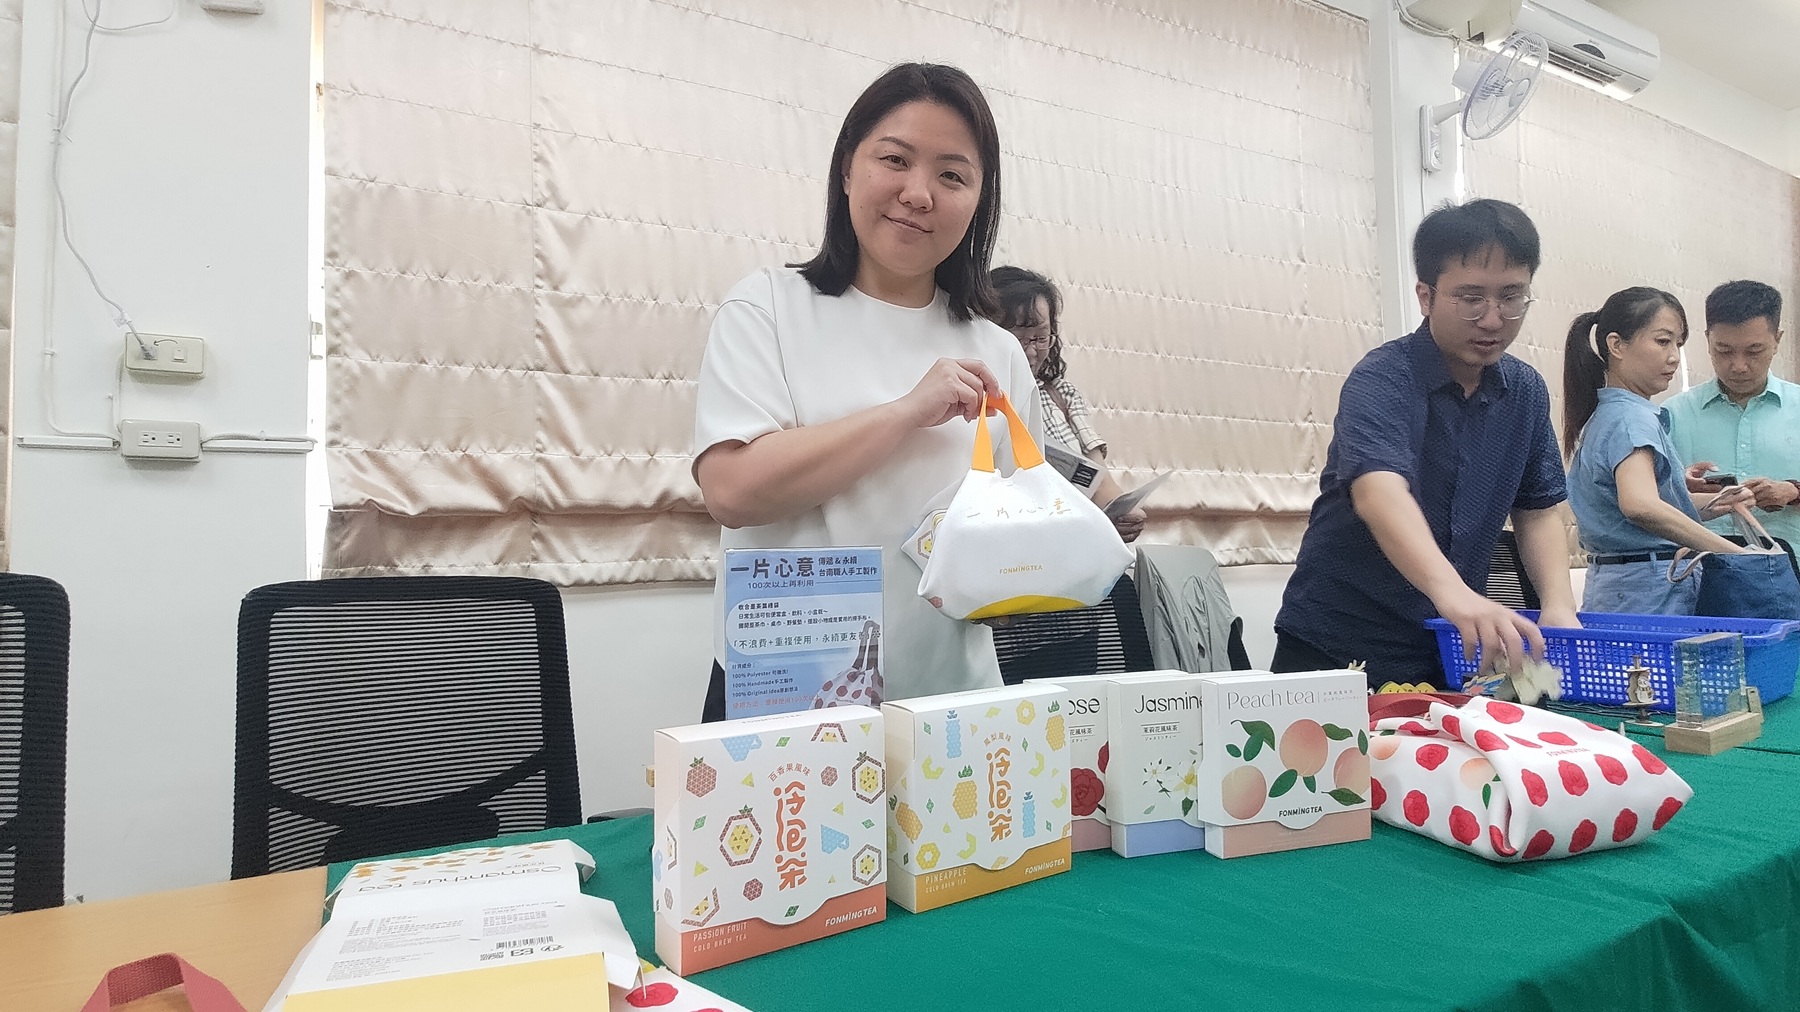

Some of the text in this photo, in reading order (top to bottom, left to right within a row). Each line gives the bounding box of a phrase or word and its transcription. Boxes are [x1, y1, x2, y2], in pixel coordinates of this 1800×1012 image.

[730, 557, 814, 579] 一片心意
[835, 557, 841, 565] &
[818, 566, 878, 577] 台南職人手工製作
[747, 580, 814, 589] 100次以上再利用
[1068, 698, 1100, 716] ose
[1227, 689, 1314, 710] Peach tea
[1069, 727, 1093, 736] 花風味茶
[1143, 724, 1178, 734] 茉莉花風味茶
[768, 763, 810, 781] 百香果風味
[412, 865, 561, 887] Osmanthus
[727, 922, 747, 934] FRUIT
[693, 942, 711, 953] COLD
[735, 933, 747, 942] TEA
